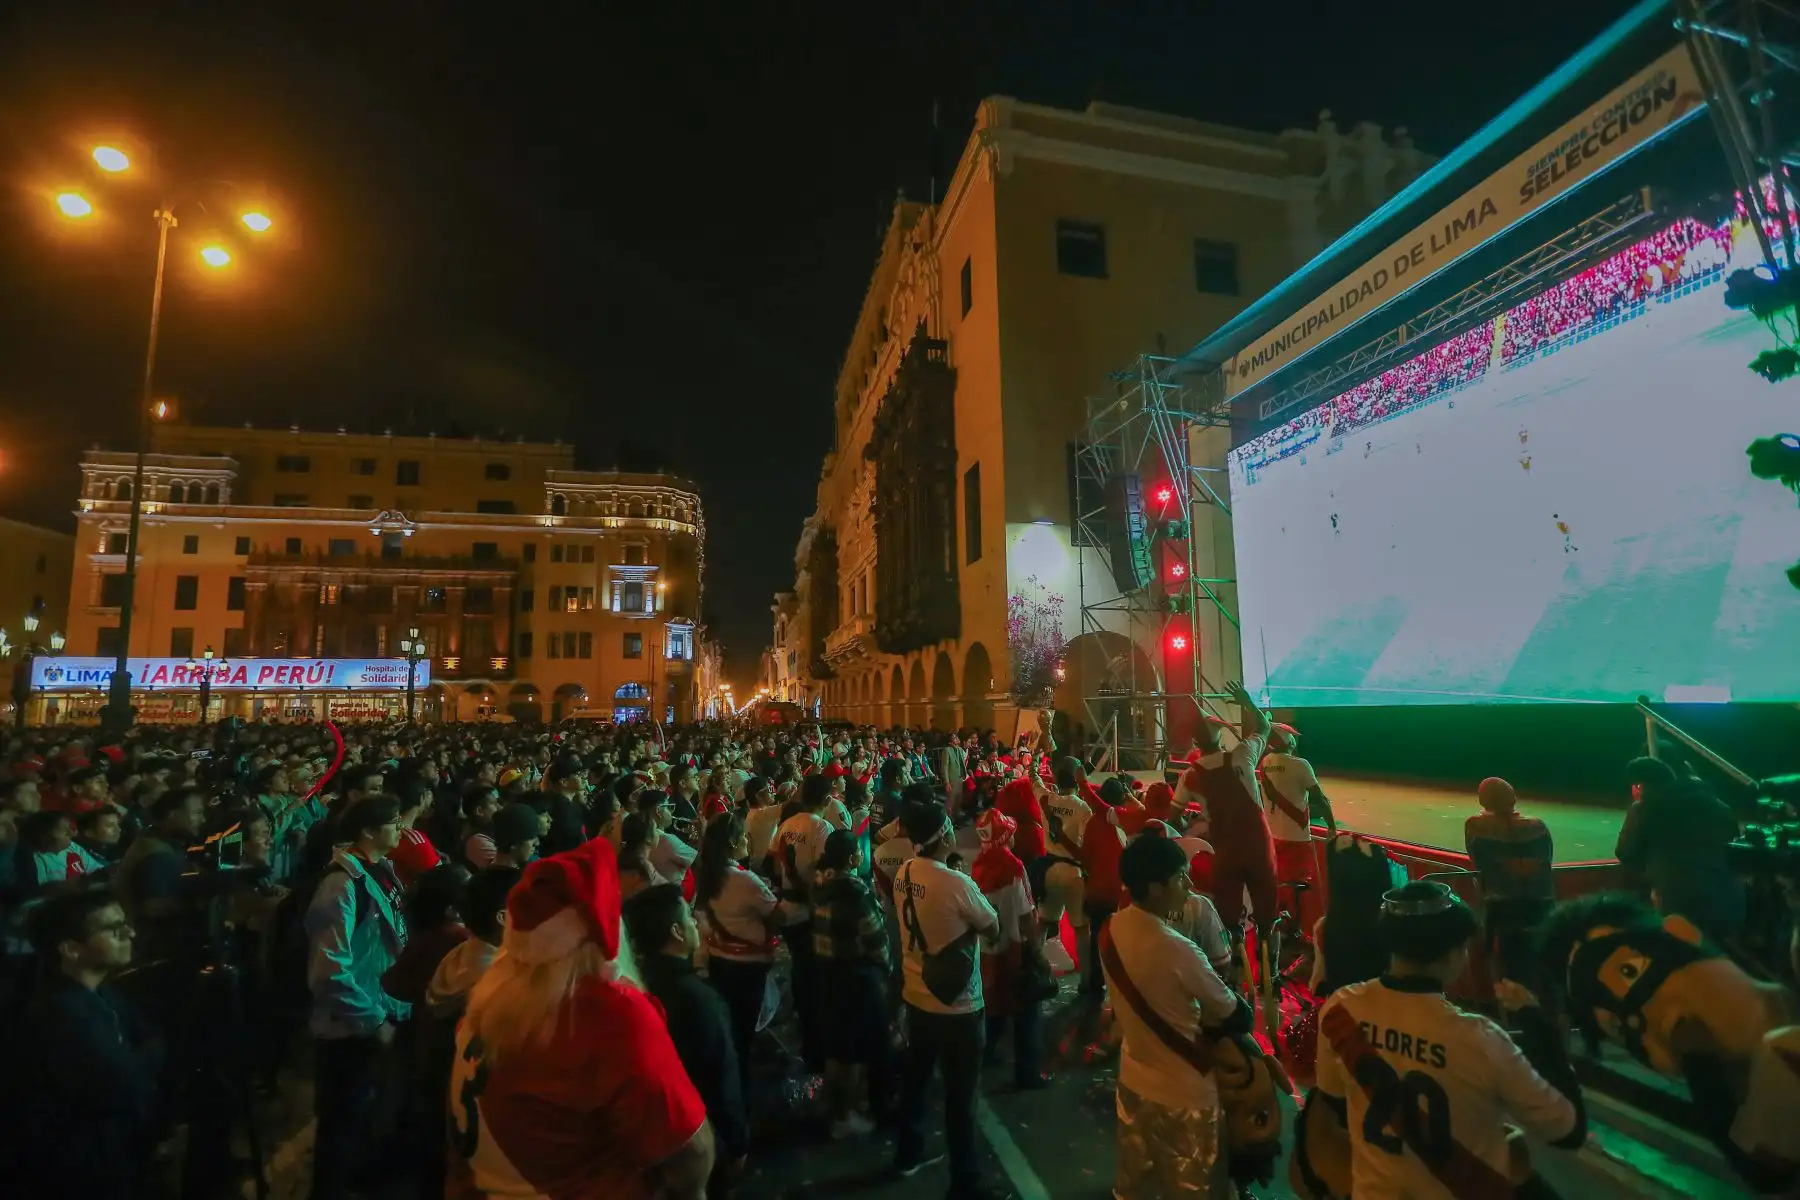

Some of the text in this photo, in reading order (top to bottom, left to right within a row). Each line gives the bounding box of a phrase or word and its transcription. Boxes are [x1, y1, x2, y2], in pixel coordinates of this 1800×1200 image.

[1250, 197, 1498, 373] MUNICIPALIDAD DE LIMA
[66, 670, 112, 682] LIMA
[257, 660, 335, 684] PERÚ!
[365, 665, 397, 673] Hospital
[361, 673, 420, 683] Solidaridd
[284, 709, 315, 718] LIMA
[895, 879, 926, 900] GUEERO
[1356, 1053, 1451, 1157] 20
